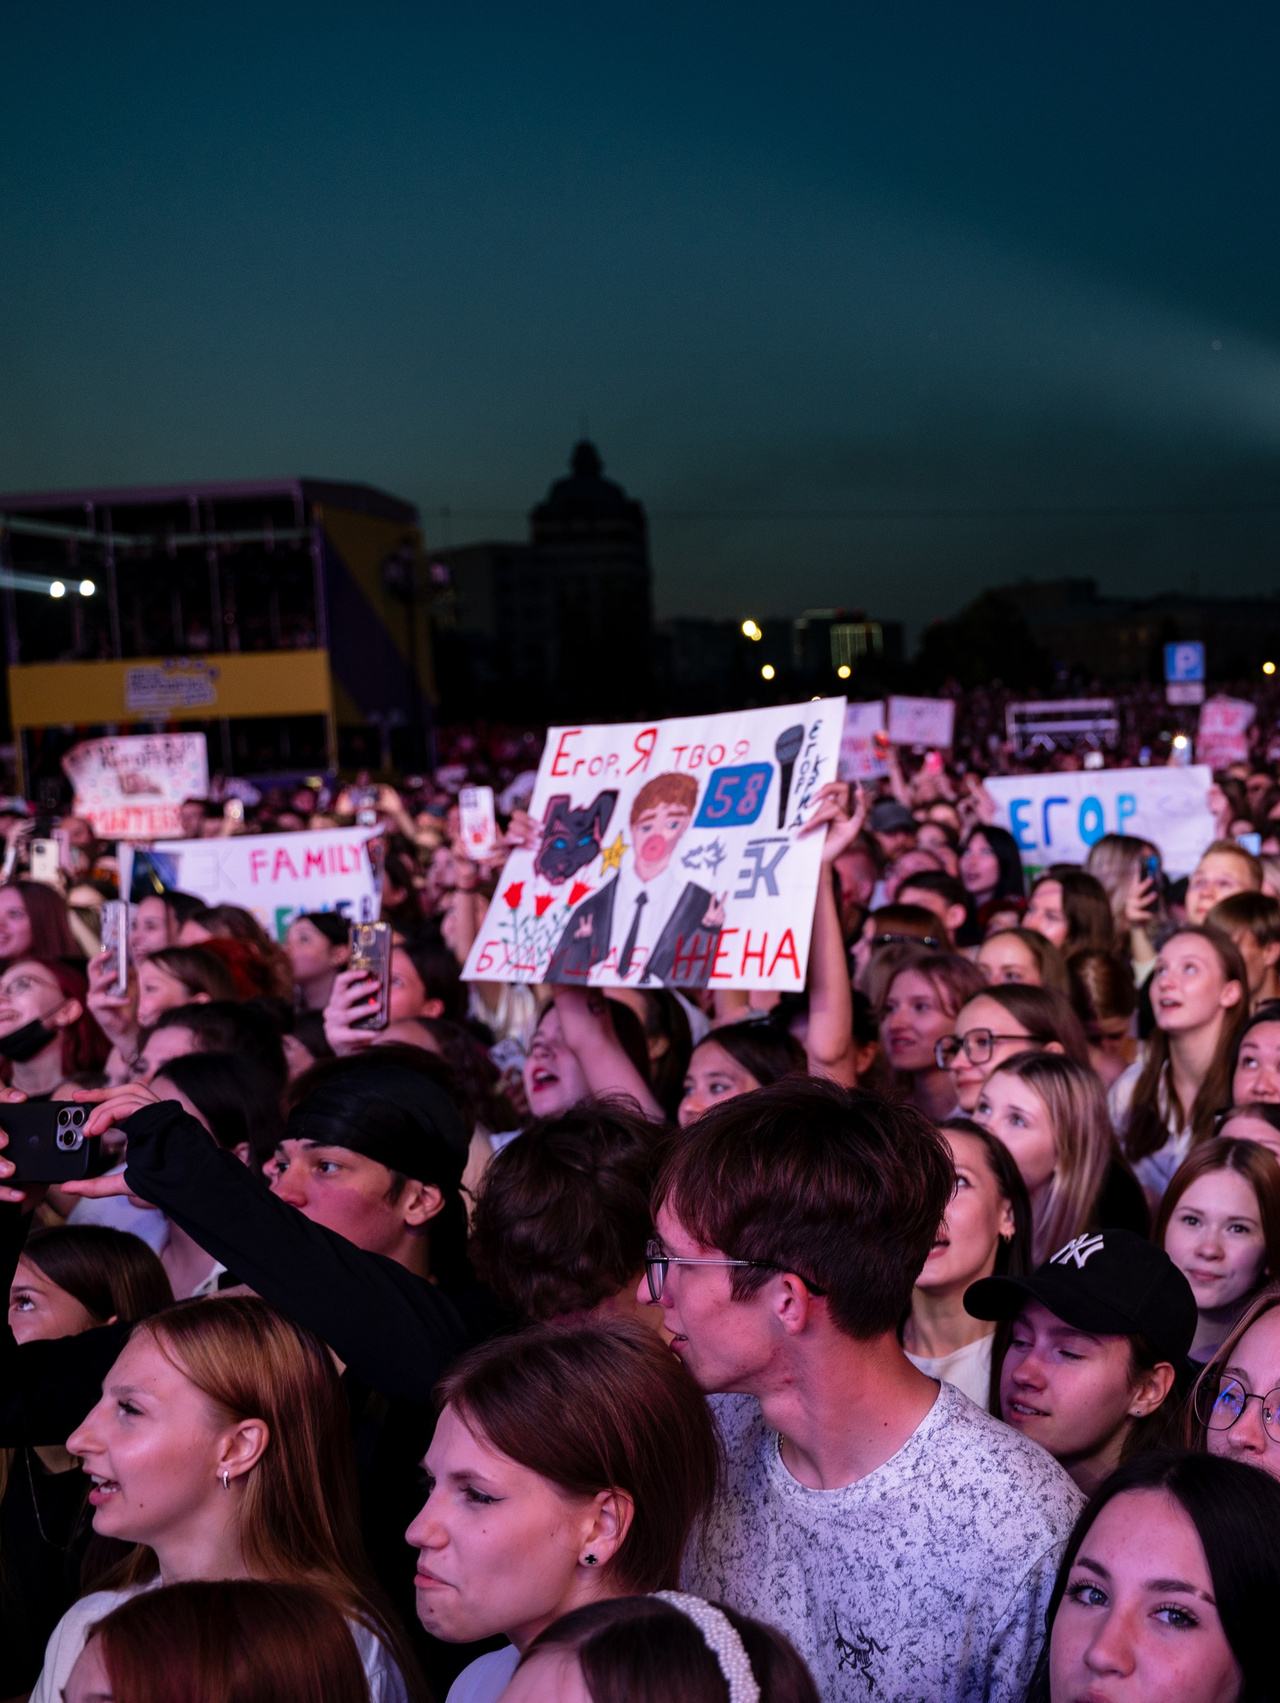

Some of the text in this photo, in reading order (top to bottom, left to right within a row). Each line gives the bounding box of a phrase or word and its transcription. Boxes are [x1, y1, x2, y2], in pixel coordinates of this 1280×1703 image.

[1175, 646, 1199, 679] P
[625, 728, 659, 777] Я
[706, 772, 766, 819] 58
[1009, 793, 1137, 851] ЕГОР
[251, 841, 364, 884] FAMILY
[671, 928, 801, 980] ЖЕНА
